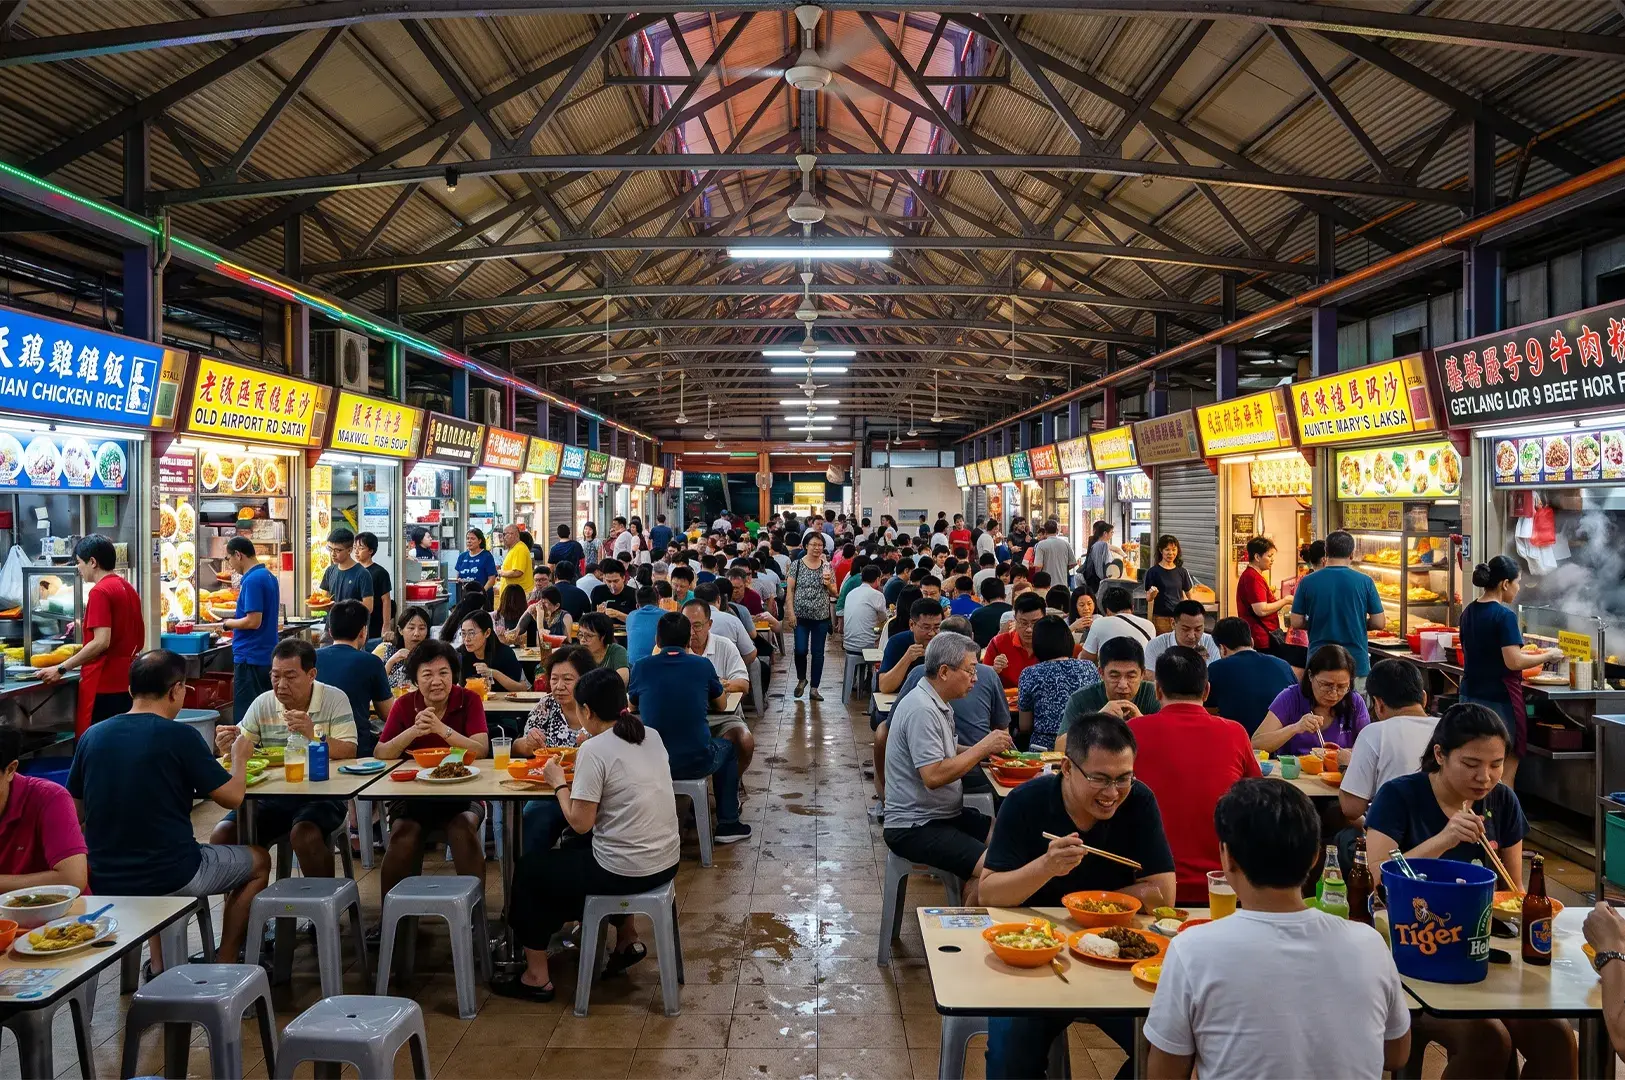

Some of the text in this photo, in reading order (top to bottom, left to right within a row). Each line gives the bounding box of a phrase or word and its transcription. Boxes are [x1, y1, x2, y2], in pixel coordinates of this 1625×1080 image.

[32, 381, 93, 407] CHICKEN
[96, 391, 124, 411] RICE
[1450, 391, 1503, 417] GEYLANG
[1505, 388, 1531, 410] LOR
[1534, 389, 1541, 406] 9
[1543, 379, 1579, 403] BEEF
[1582, 374, 1616, 398] HOR
[195, 407, 306, 437] OLD AIRPORT RD SATAY
[1303, 409, 1408, 437] AUNTIE MARY'S LAKSA
[390, 438, 408, 450] SOUP
[1394, 921, 1463, 955] Tiger
